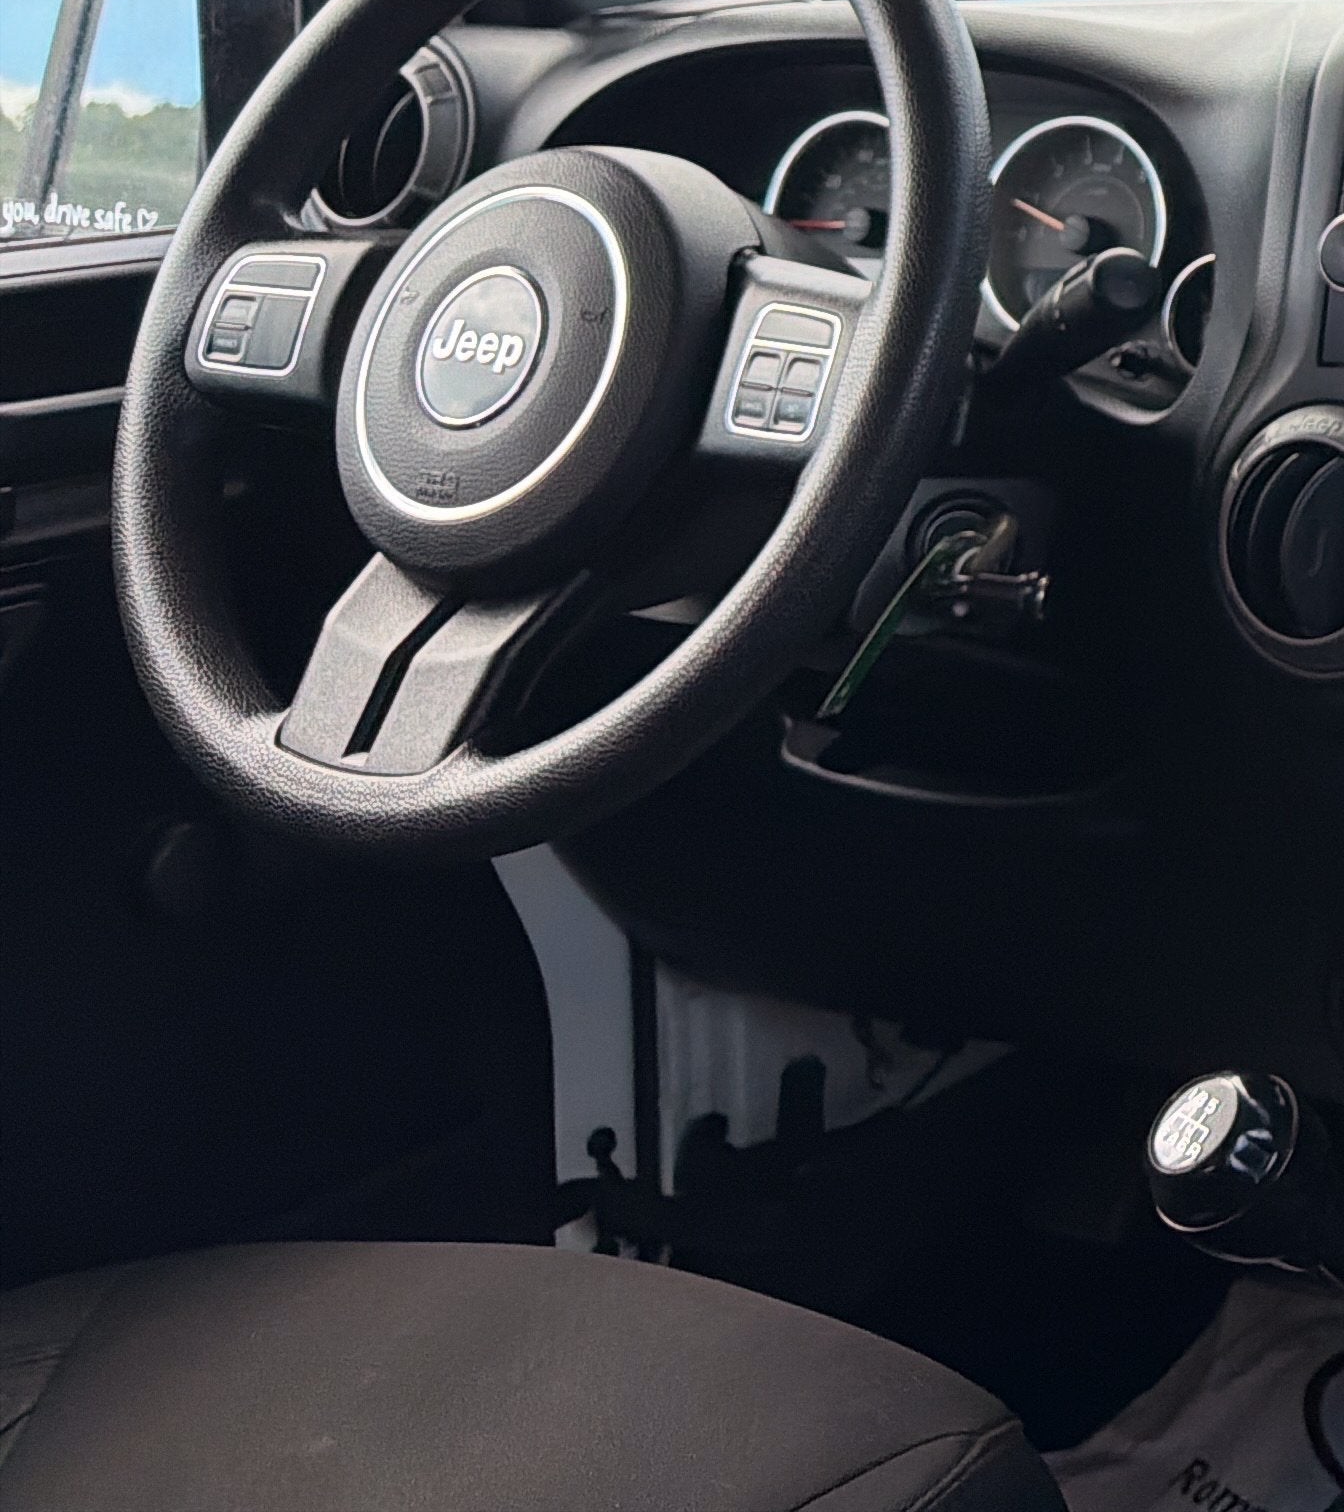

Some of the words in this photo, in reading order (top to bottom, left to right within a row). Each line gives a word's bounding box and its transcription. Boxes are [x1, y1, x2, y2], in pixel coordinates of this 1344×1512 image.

[43, 191, 91, 228] drive
[93, 201, 132, 233] safe
[431, 318, 525, 374] Jeep
